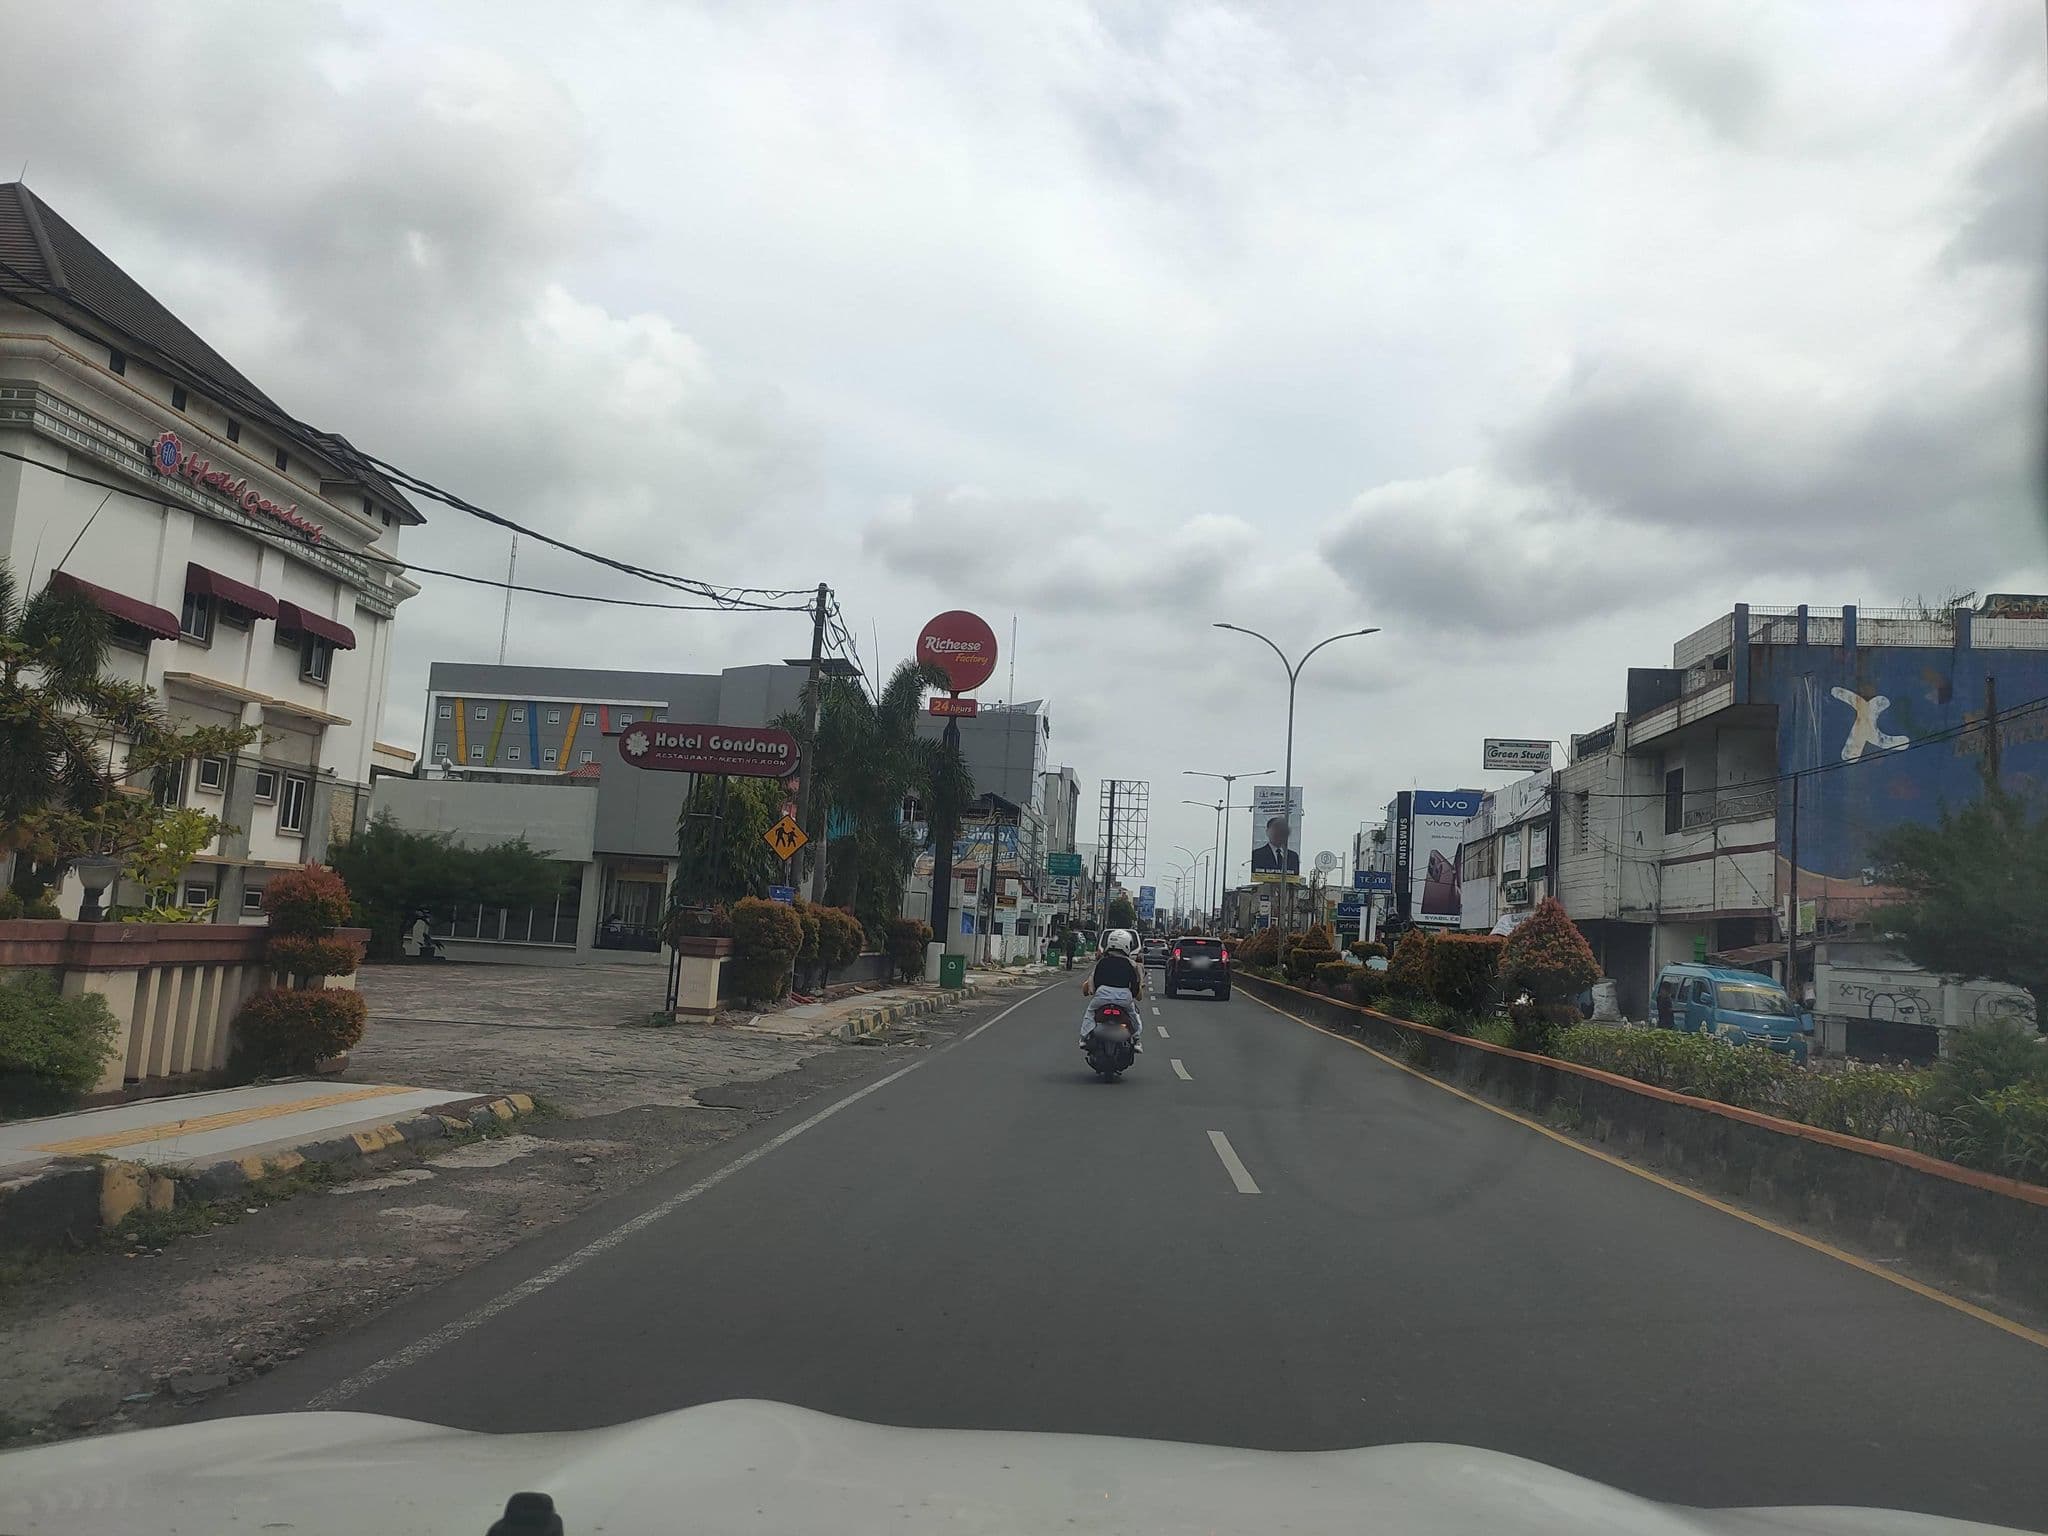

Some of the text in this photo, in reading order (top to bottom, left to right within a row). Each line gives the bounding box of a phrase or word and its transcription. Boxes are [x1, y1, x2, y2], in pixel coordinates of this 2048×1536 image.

[184, 451, 324, 544] Hotel Gondang
[925, 636, 982, 653] Richeese
[955, 653, 988, 665] Factory
[933, 700, 949, 712] 24
[950, 704, 972, 712] hours
[655, 732, 789, 759] Hotel Gondang
[1490, 749, 1550, 760] Green Studio
[1430, 798, 1468, 810] vivo
[1425, 819, 1451, 827] vivo
[1399, 817, 1408, 866] SAMSUNG
